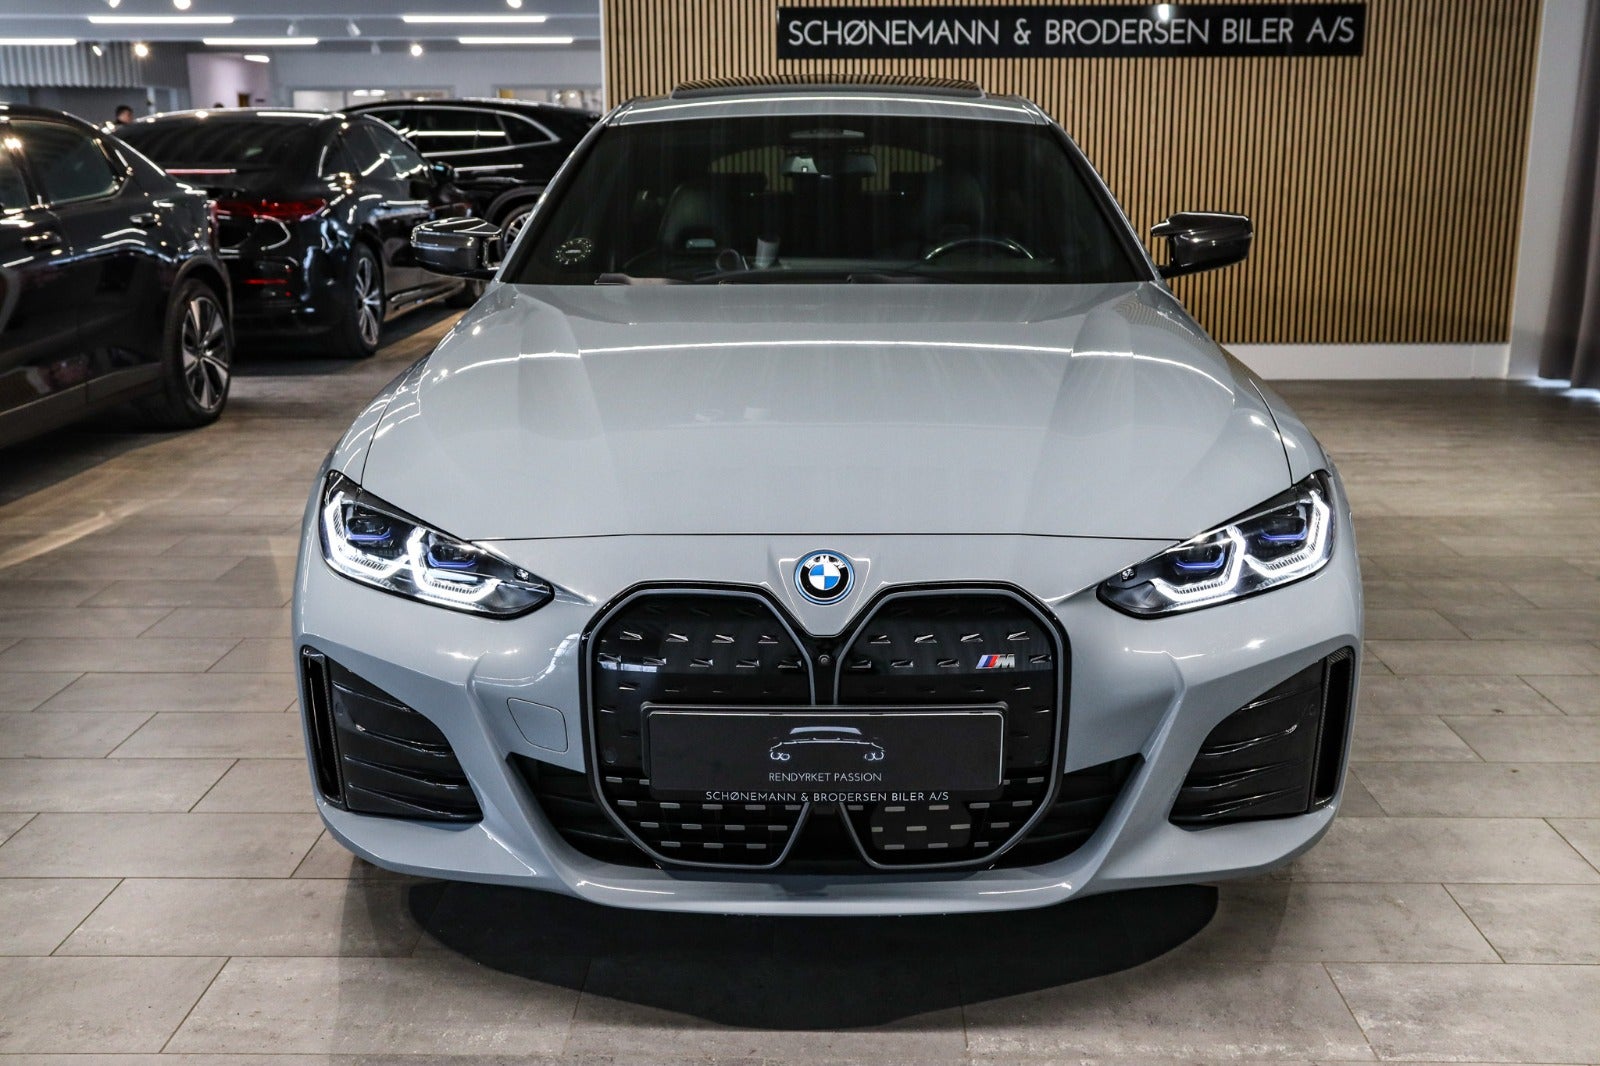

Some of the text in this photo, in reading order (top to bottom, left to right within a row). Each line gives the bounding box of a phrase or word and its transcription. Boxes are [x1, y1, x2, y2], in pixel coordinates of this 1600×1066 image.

[788, 16, 1355, 46] SCHØNEMANN & BRODERSEN BILER A/S
[804, 555, 846, 569] BMW
[768, 772, 882, 782] RENDYRKET PASSION
[705, 791, 949, 802] SCHØNEMANN & BRODERSEN BILER A/S
